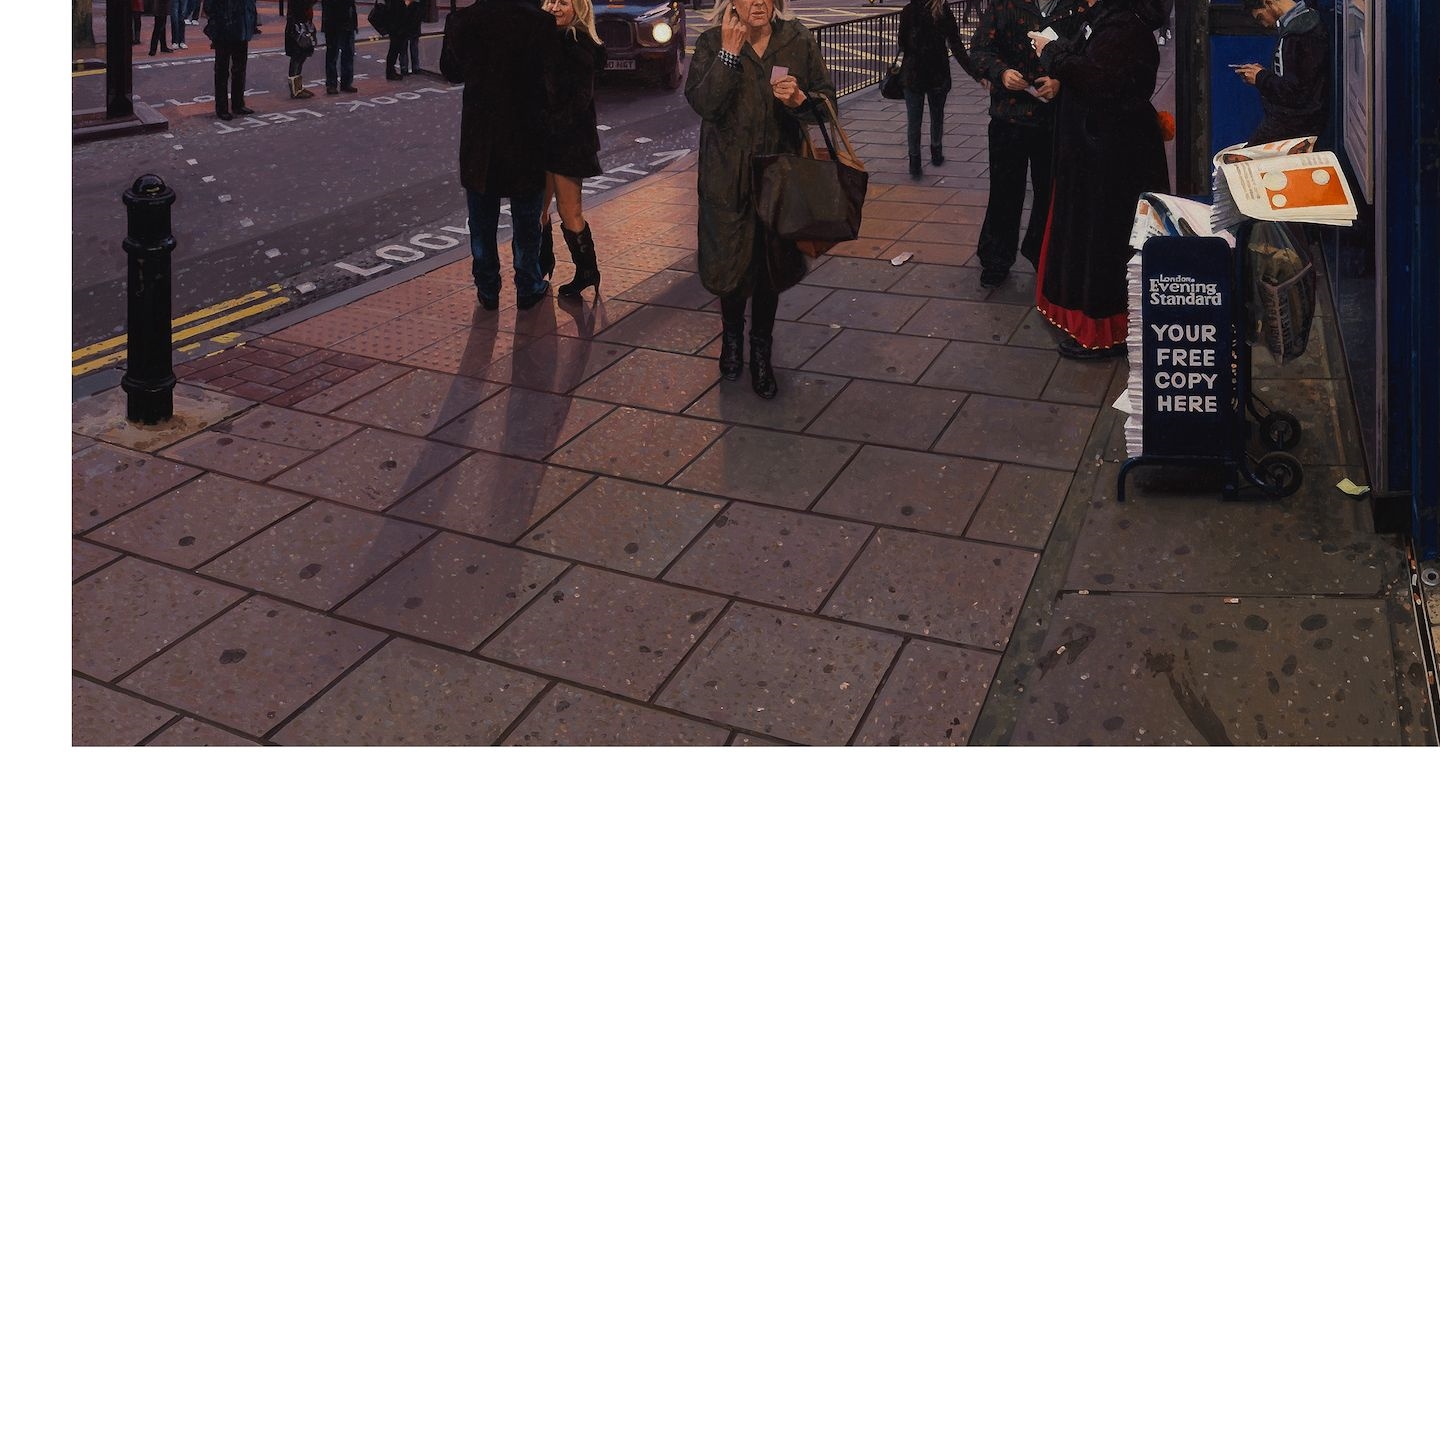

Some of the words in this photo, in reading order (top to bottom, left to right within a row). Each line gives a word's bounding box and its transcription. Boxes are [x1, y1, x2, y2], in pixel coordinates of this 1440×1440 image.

[212, 108, 325, 135] LEFT
[1149, 278, 1218, 296] Evening
[1150, 292, 1222, 307] Standard
[1151, 323, 1217, 343] YOUR
[1157, 348, 1216, 367] FREE
[1154, 371, 1218, 390] COPY
[1157, 394, 1218, 413] HERE
